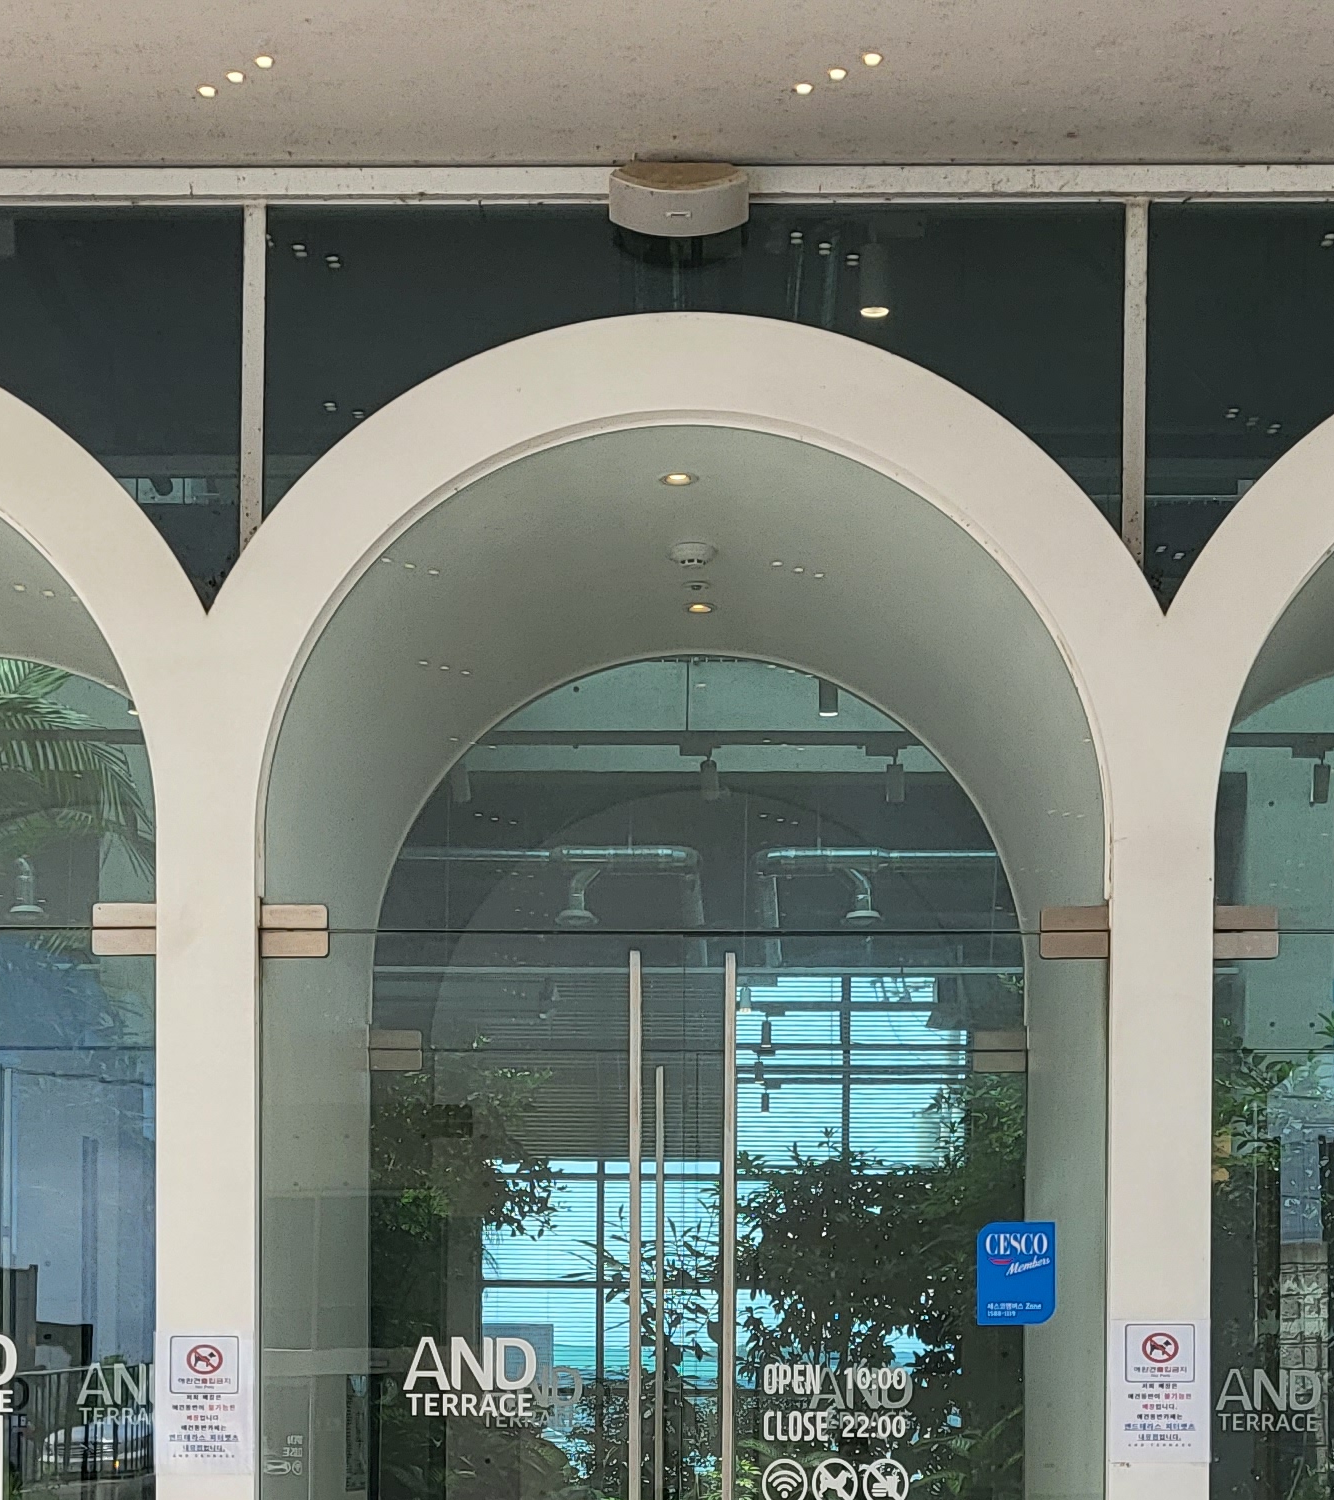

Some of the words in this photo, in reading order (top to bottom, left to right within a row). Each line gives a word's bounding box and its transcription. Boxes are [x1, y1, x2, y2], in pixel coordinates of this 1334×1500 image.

[985, 1232, 1048, 1255] CESCO
[1005, 1255, 1051, 1276] Members
[402, 1336, 537, 1391] AND
[763, 1363, 821, 1395] OPEN
[844, 1367, 907, 1390] 10:00
[76, 1362, 153, 1406] AN
[1215, 1368, 1322, 1411] AND
[405, 1393, 534, 1417] TERRACE
[763, 1410, 829, 1442] CLOSE
[841, 1415, 906, 1438] 22:00
[1217, 1413, 1319, 1432] TERRACE
